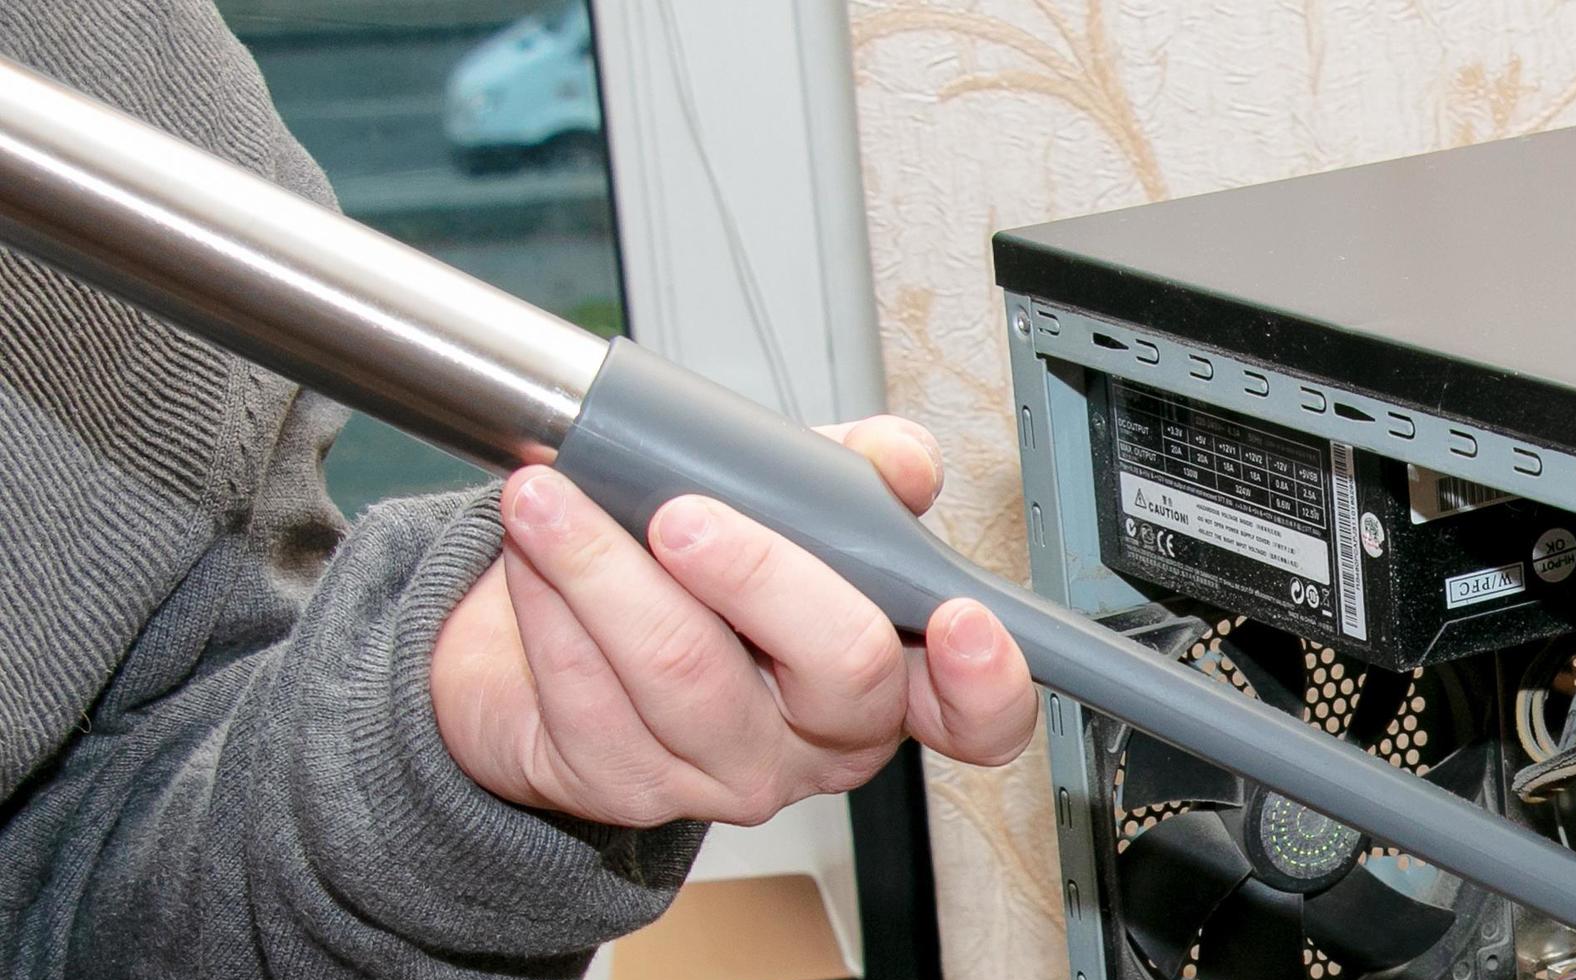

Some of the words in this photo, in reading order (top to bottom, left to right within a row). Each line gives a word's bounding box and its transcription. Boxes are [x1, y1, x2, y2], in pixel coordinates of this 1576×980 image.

[1167, 425, 1183, 438] +3.3V
[1195, 435, 1207, 446] +5V
[1218, 442, 1236, 455] +12V1
[1245, 451, 1264, 465] +12V2
[1273, 460, 1288, 473] -12V
[1298, 468, 1319, 483] +5VSB
[1170, 444, 1183, 456] 20A
[1196, 452, 1209, 464] 20A
[1249, 470, 1262, 482] 18A
[1275, 479, 1290, 492] 0.8A
[1302, 489, 1317, 501] 2.5A
[1148, 501, 1190, 525] CAUTION!
[1545, 538, 1566, 554] OK
[1540, 554, 1576, 573] HI-POT
[1458, 572, 1513, 597] W/PFC
